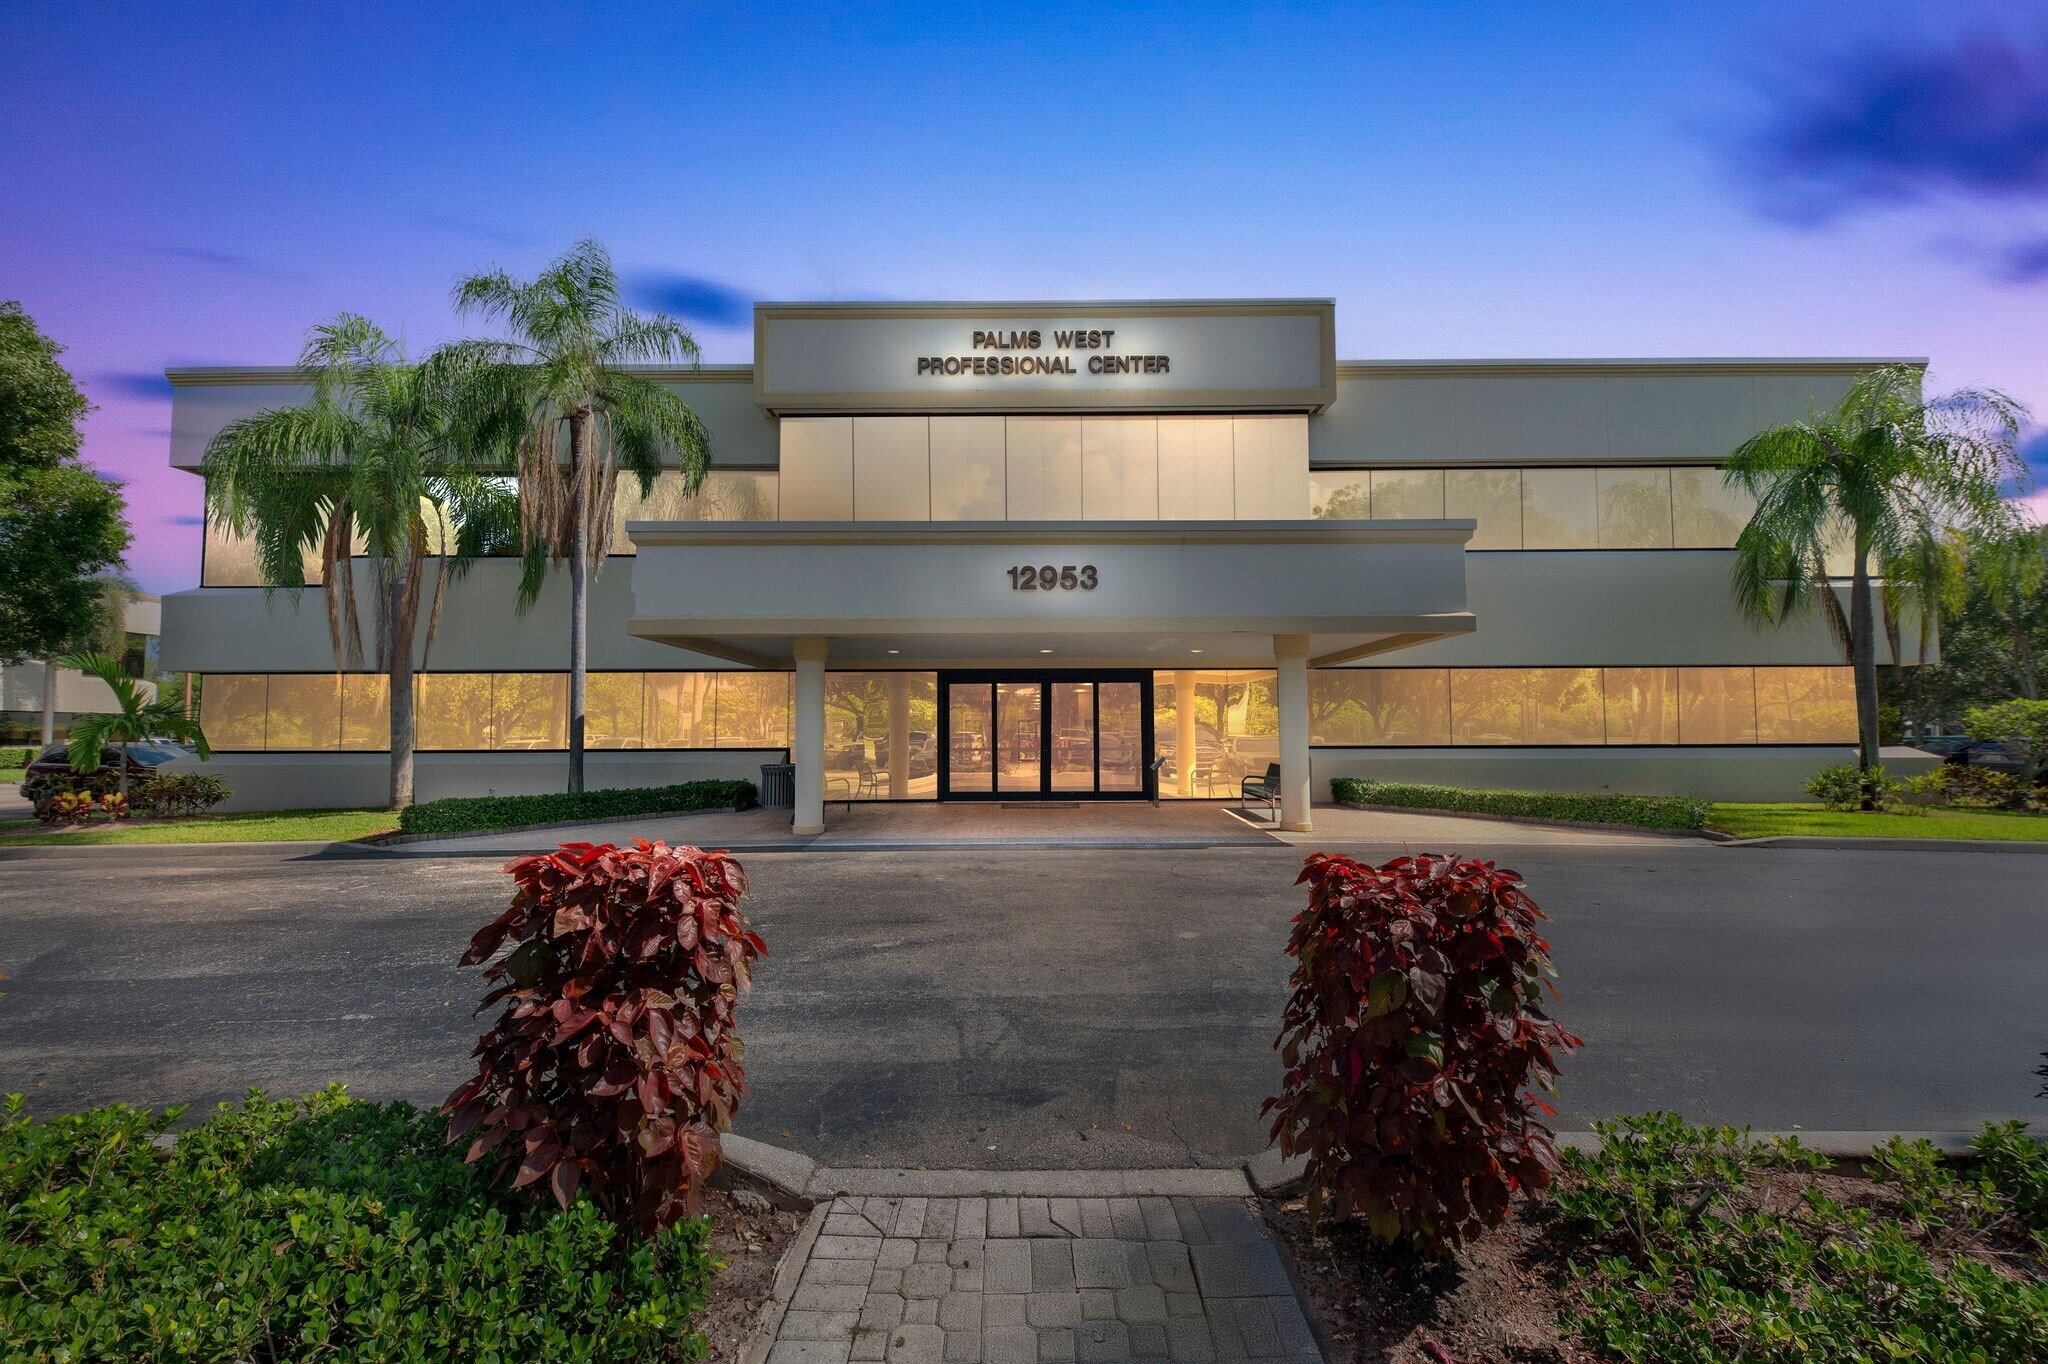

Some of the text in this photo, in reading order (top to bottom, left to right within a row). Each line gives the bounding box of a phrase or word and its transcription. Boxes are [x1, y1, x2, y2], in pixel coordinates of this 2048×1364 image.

[972, 331, 1115, 349] PALMS WEST
[917, 355, 1171, 375] PROFESSIONAL CENTER
[1006, 565, 1099, 590] 12953
